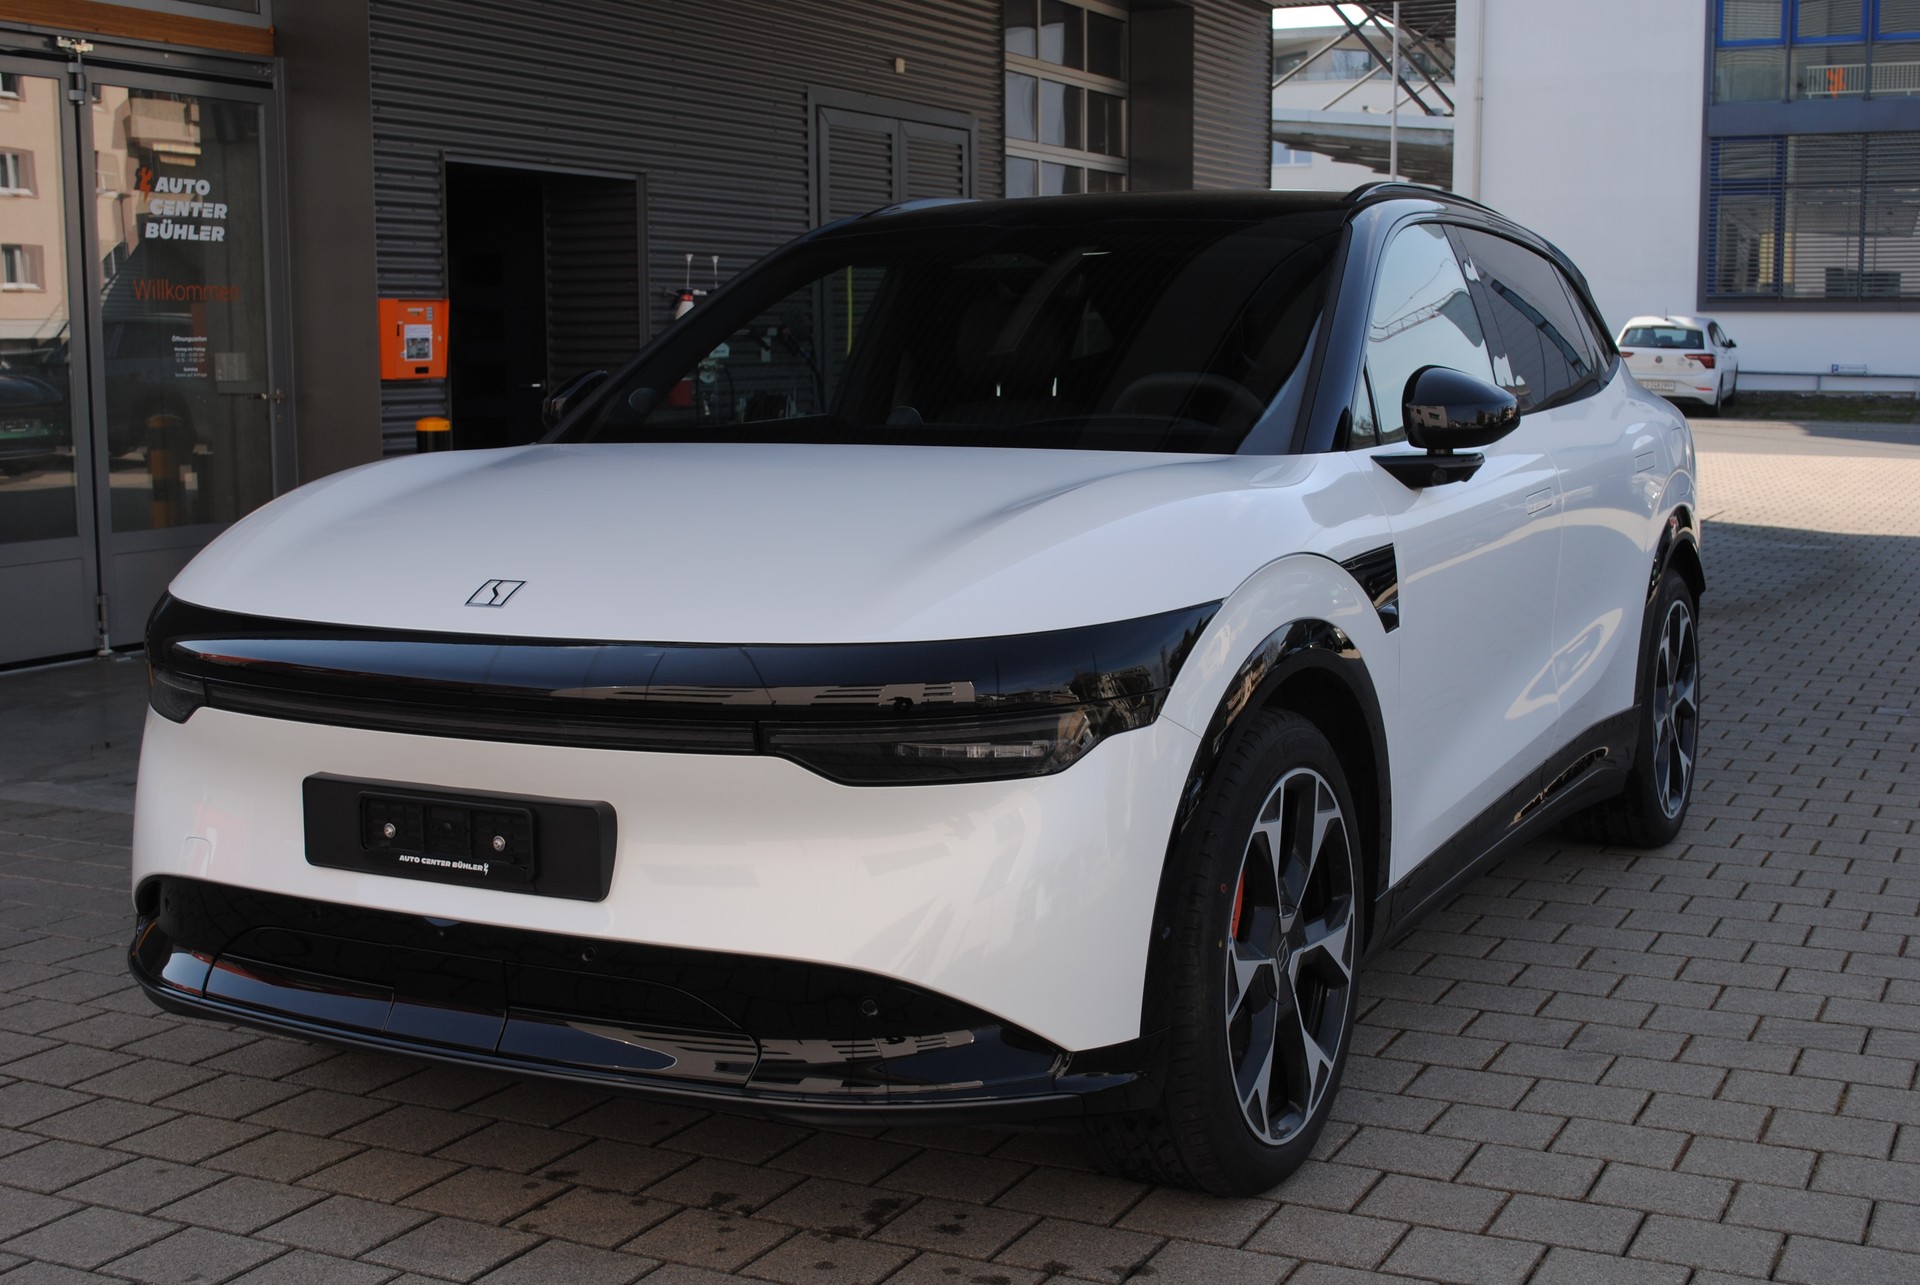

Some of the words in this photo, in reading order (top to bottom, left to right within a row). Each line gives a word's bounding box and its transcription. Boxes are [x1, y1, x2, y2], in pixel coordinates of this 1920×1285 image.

[155, 176, 211, 196] AUTO
[149, 200, 228, 219] CENTER
[145, 219, 226, 242] BÜHLER
[134, 279, 240, 301] Willkommen
[399, 855, 420, 863] AUTO
[421, 858, 451, 867] CENTER
[452, 861, 483, 871] BÜHLER
